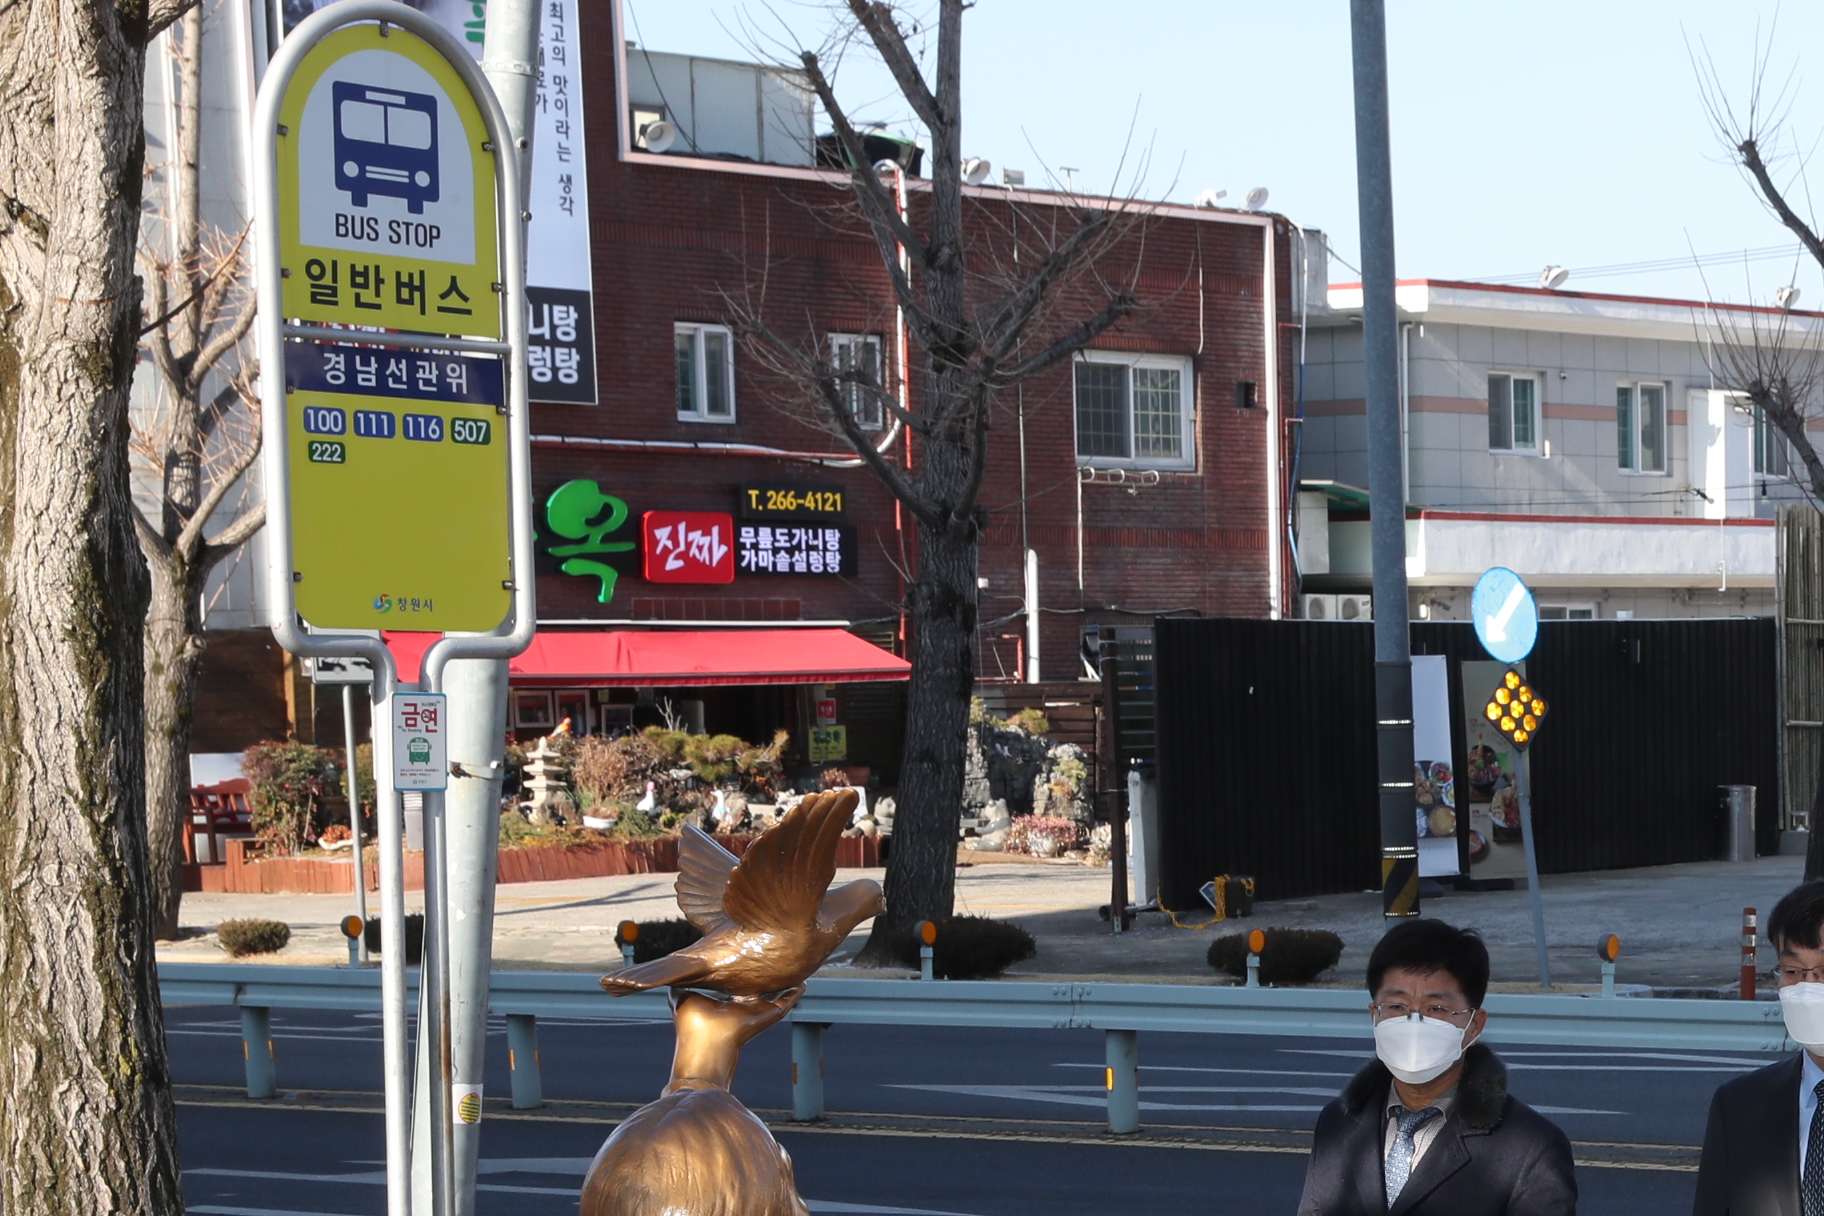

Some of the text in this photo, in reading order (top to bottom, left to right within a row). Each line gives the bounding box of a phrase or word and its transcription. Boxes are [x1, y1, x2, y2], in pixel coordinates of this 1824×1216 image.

[549, 2, 575, 218] 최고의 맛이라는 생각
[334, 212, 442, 249] BUS STOP
[304, 257, 473, 317] 일반버스
[322, 351, 469, 396] 경남선관위
[527, 345, 581, 385] 렁탕
[306, 408, 488, 443] 100 111 116 507
[311, 442, 343, 463] 222
[747, 489, 843, 512] T. 266-4121
[531, 478, 636, 604] 옥
[653, 520, 729, 572] 진짜
[739, 526, 841, 551] 무릎도가니탕
[740, 549, 842, 574] 가마솥설렁탕
[397, 597, 433, 612] 창원시
[401, 702, 438, 733] 금연
